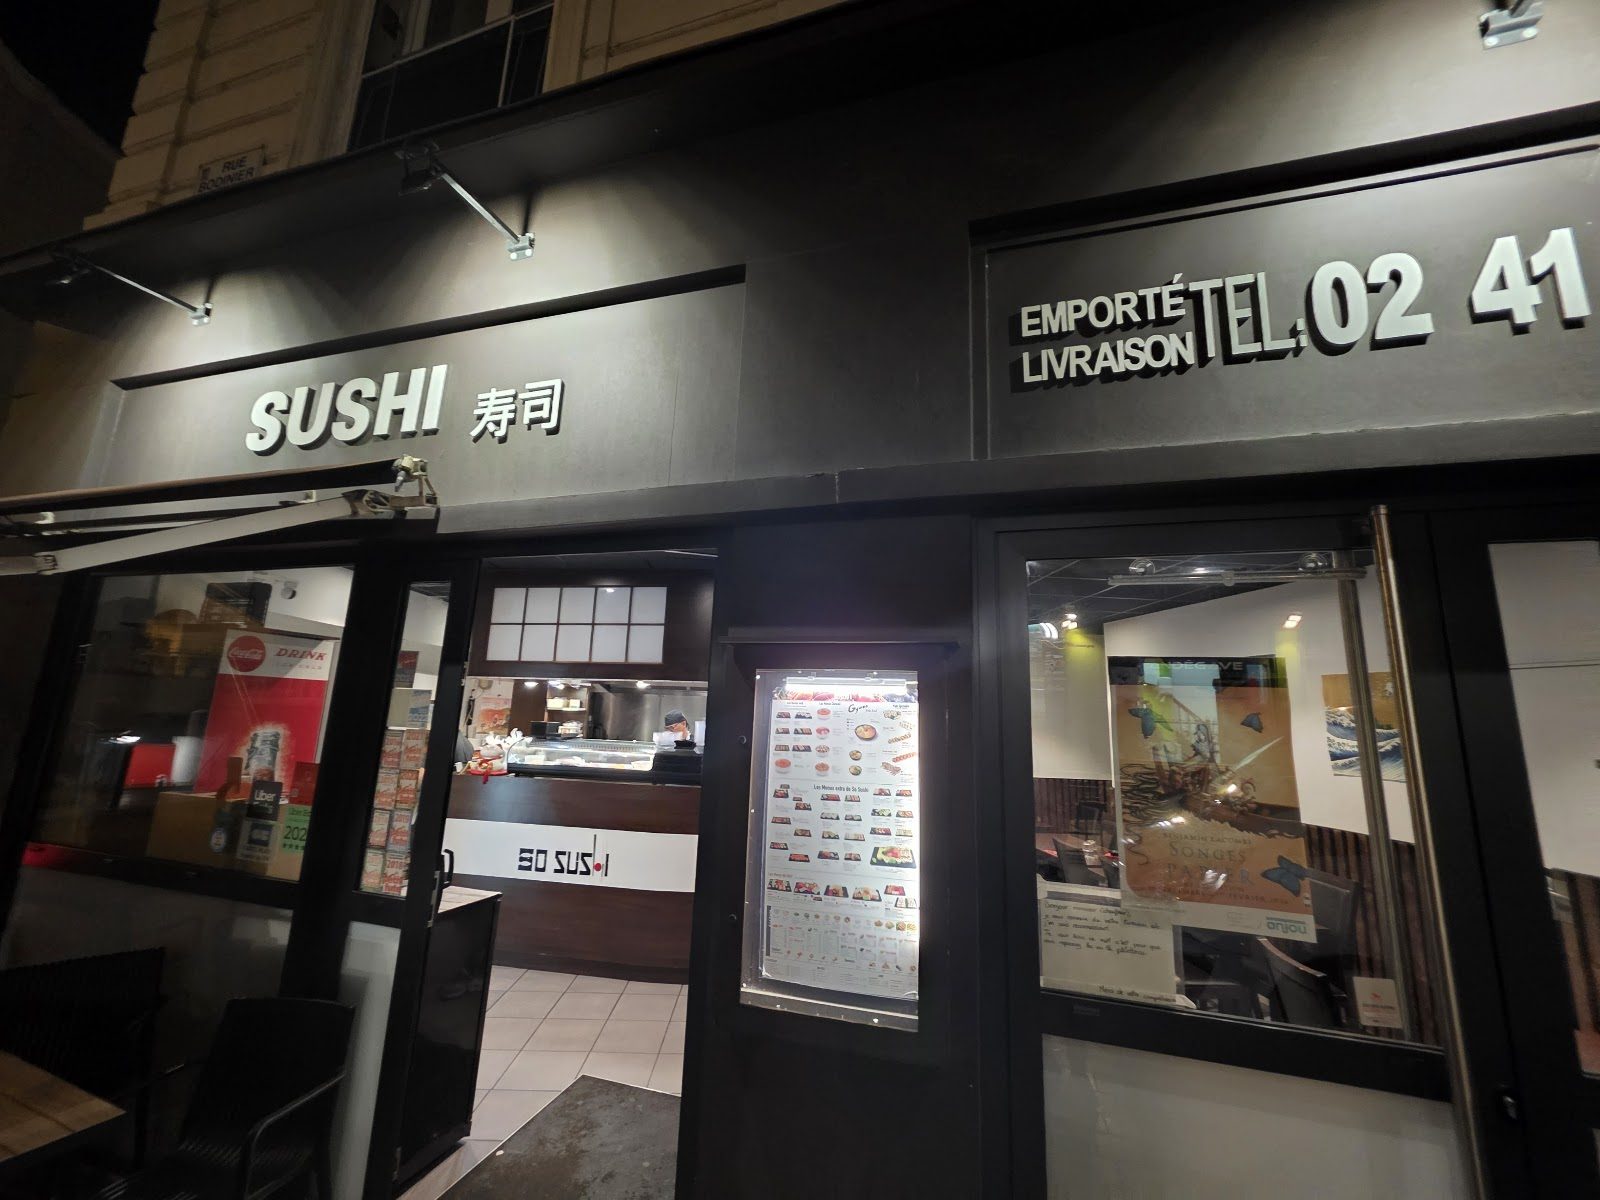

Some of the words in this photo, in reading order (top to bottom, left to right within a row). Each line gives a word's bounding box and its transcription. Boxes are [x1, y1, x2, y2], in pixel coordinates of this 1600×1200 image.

[222, 156, 247, 172] RUE
[1021, 273, 1187, 337] EMPORTÉ
[1312, 252, 1435, 345] 02
[1471, 227, 1591, 325] 41
[1022, 331, 1195, 383] LIVRAISON
[246, 364, 448, 452] SUSHI
[470, 378, 563, 437] 寿司
[274, 647, 328, 661] DRINK
[1168, 841, 1247, 863] SONGES
[1266, 920, 1307, 935] anjou
